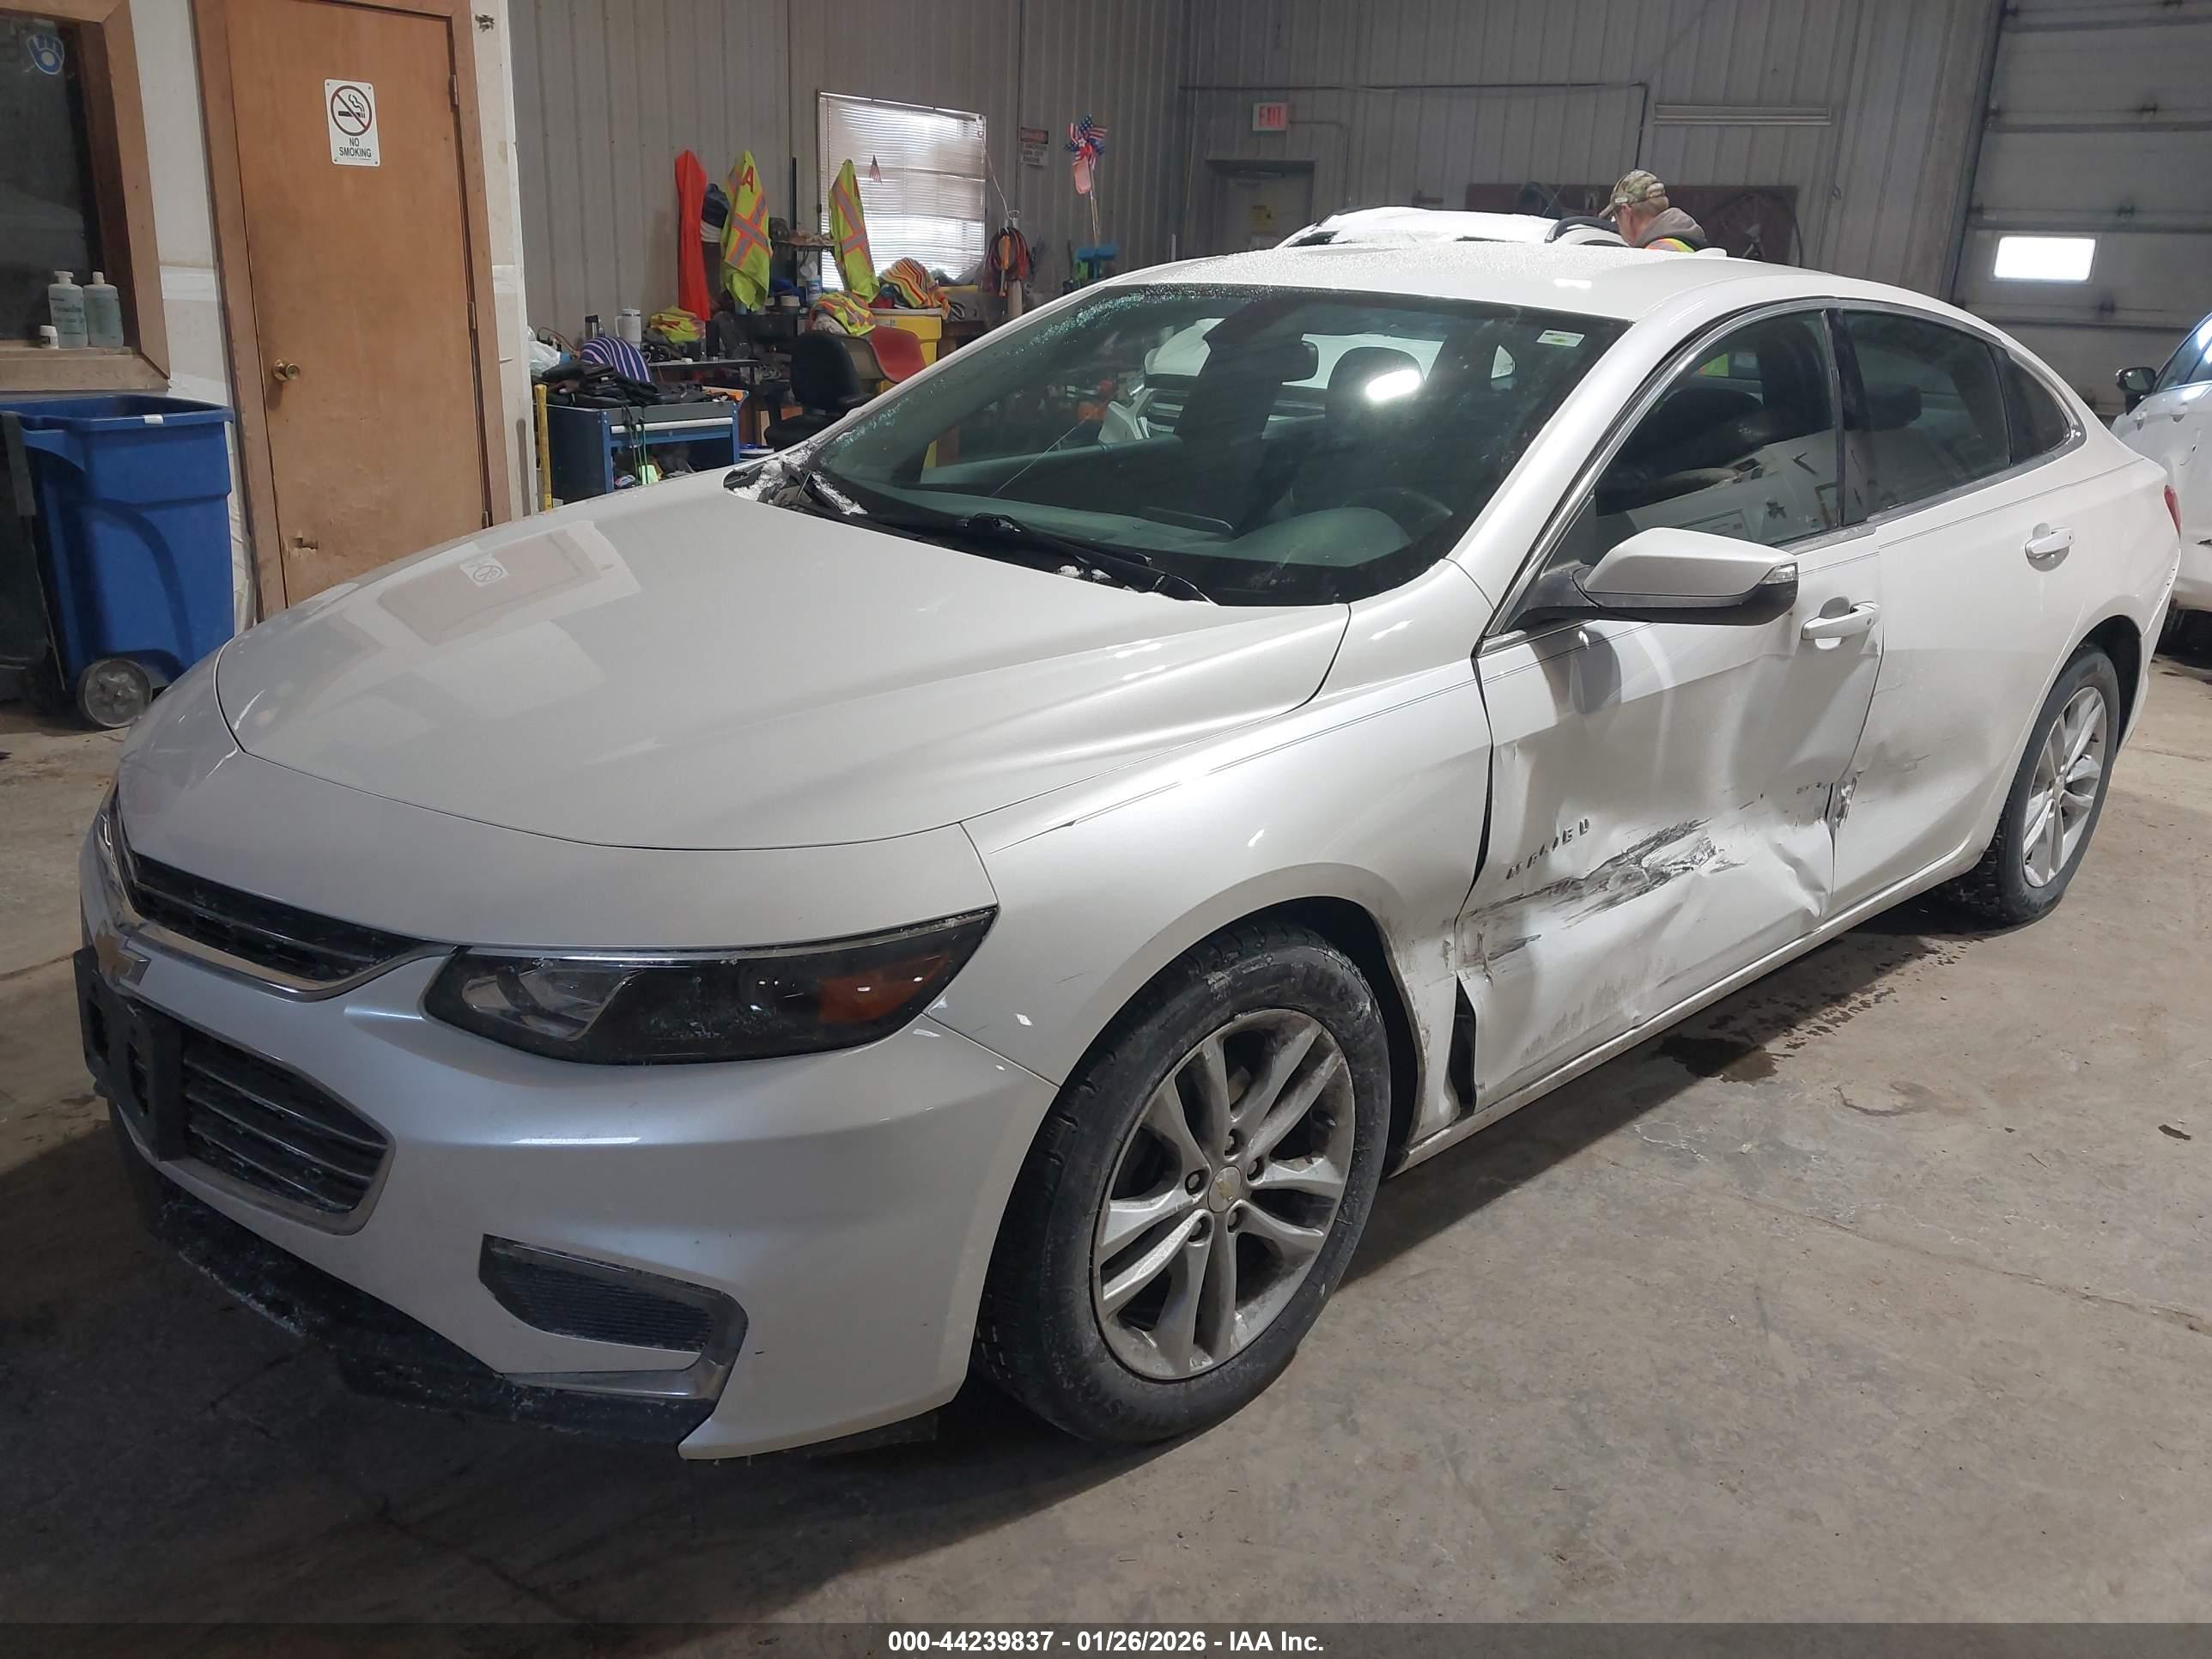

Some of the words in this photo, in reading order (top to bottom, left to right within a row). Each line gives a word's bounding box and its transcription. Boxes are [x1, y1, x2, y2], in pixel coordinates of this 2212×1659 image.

[1259, 106, 1284, 126] EXIT
[349, 137, 360, 147] NO
[339, 147, 372, 157] SMOKING
